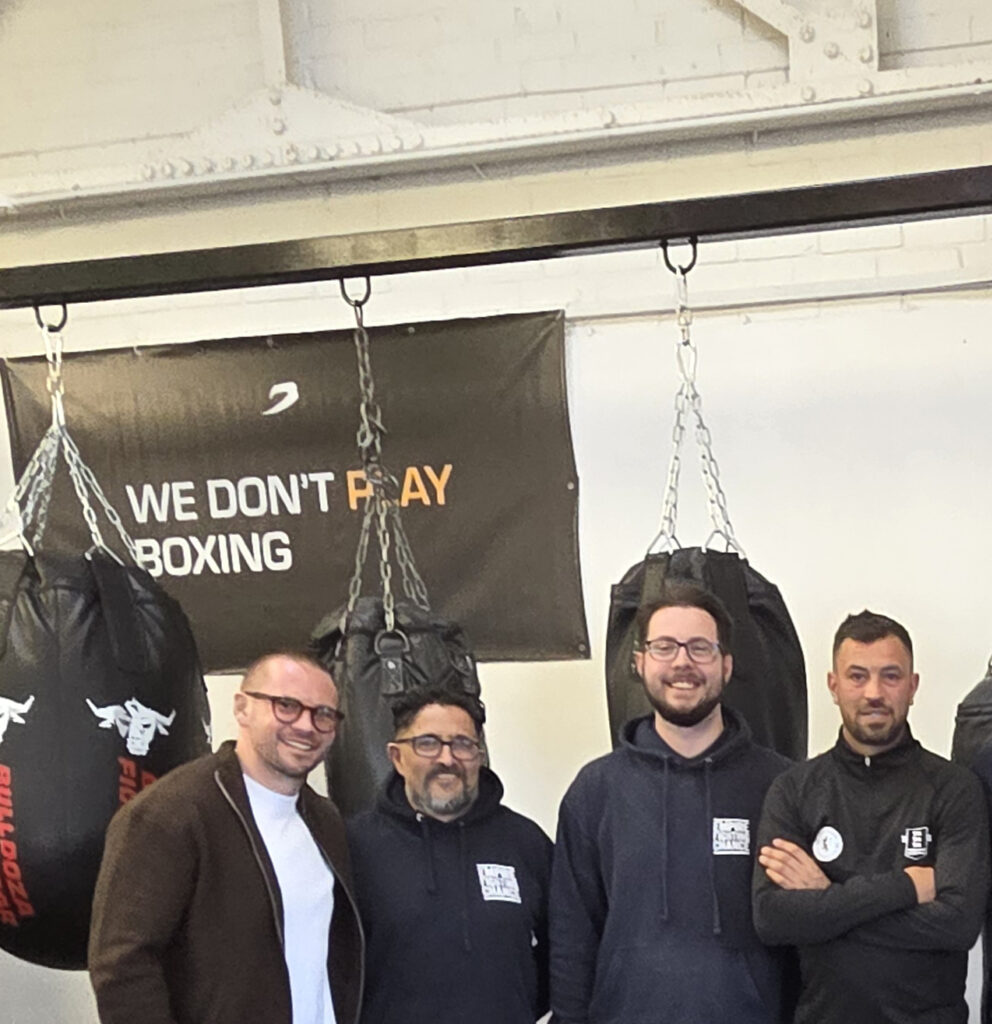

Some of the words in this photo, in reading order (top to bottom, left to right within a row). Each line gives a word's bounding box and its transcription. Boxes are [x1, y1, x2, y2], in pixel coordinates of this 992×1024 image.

[126, 481, 198, 524] WE
[206, 472, 335, 518] DON'T
[346, 464, 453, 510] PAY
[135, 530, 293, 578] BOXING
